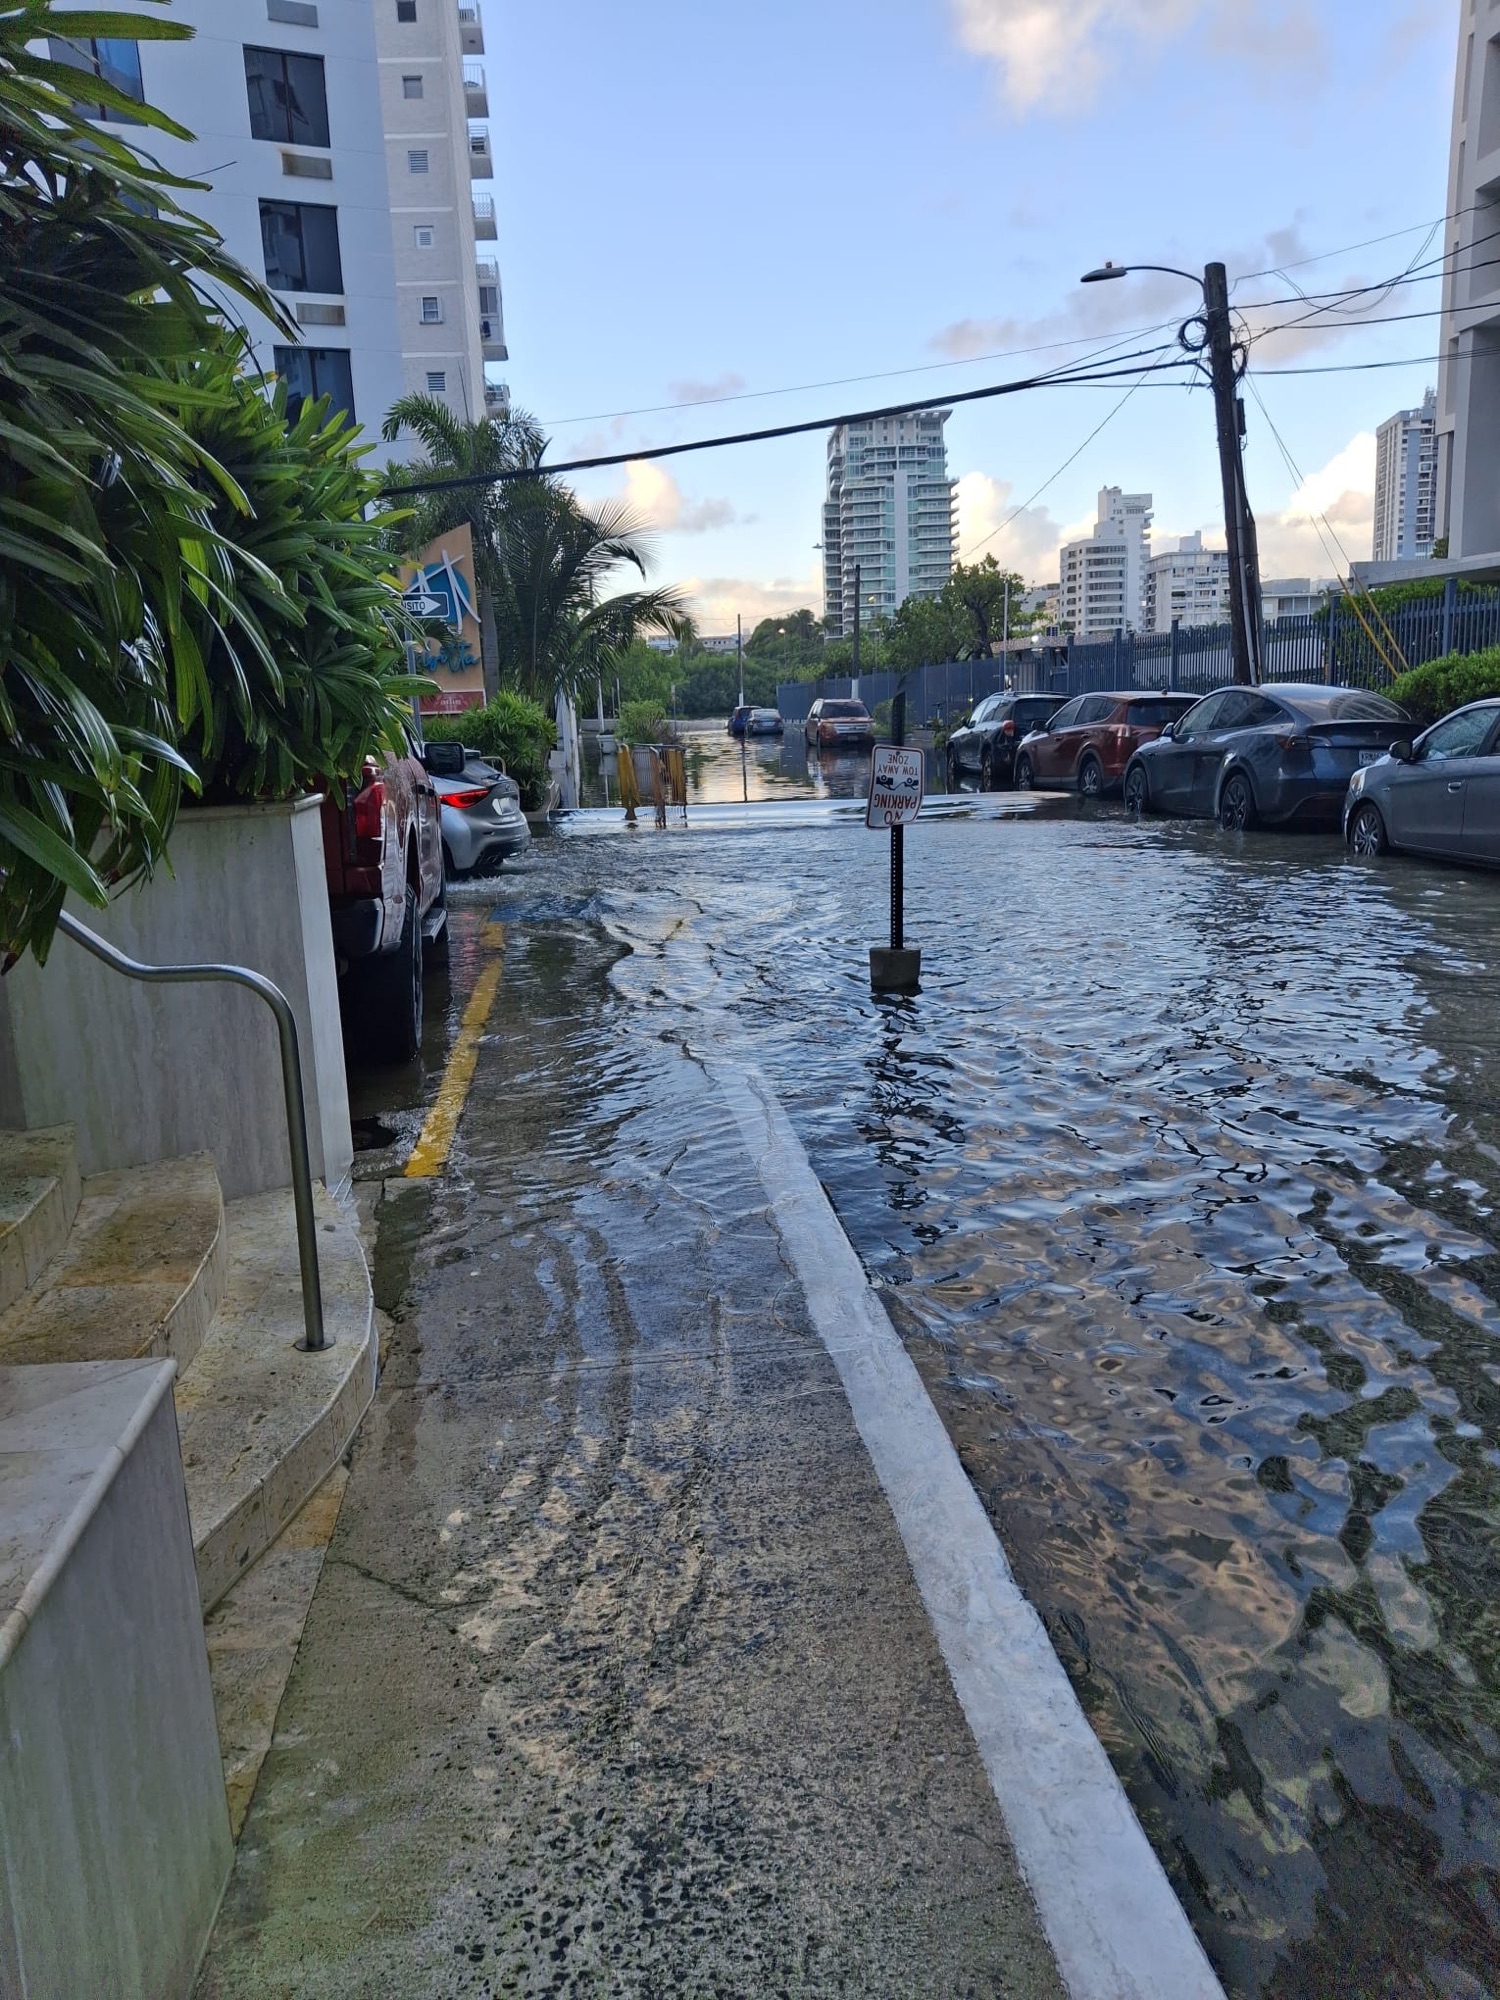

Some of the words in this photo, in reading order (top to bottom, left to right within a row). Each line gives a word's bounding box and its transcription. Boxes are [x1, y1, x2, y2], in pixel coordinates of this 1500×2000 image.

[887, 754, 909, 765] ZONE
[877, 764, 899, 775] AWAY
[902, 766, 918, 776] TOW
[874, 793, 918, 809] PARKING
[884, 810, 903, 825] NO
